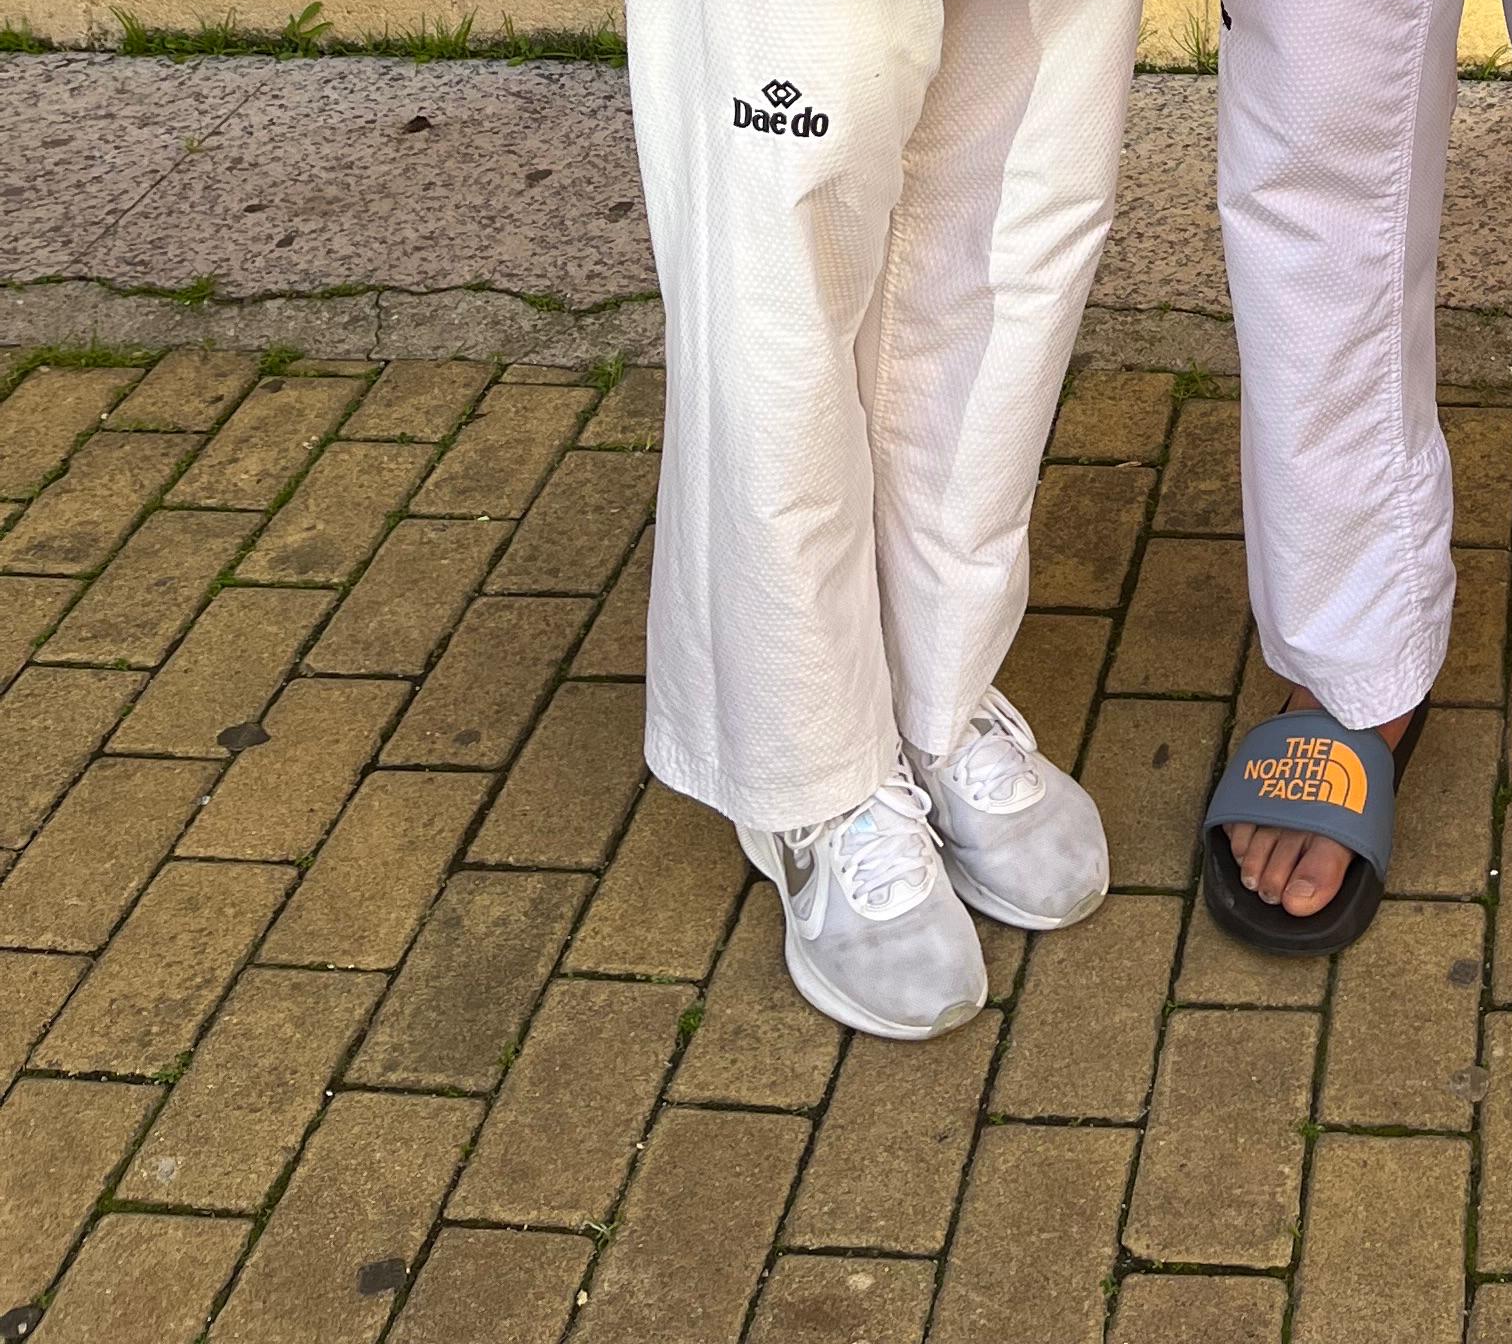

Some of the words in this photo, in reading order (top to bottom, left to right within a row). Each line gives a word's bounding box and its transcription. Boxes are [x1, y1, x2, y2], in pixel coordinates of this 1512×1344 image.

[1286, 737, 1332, 759] THE
[1243, 759, 1327, 780] NORTH
[1258, 779, 1321, 801] FACE
